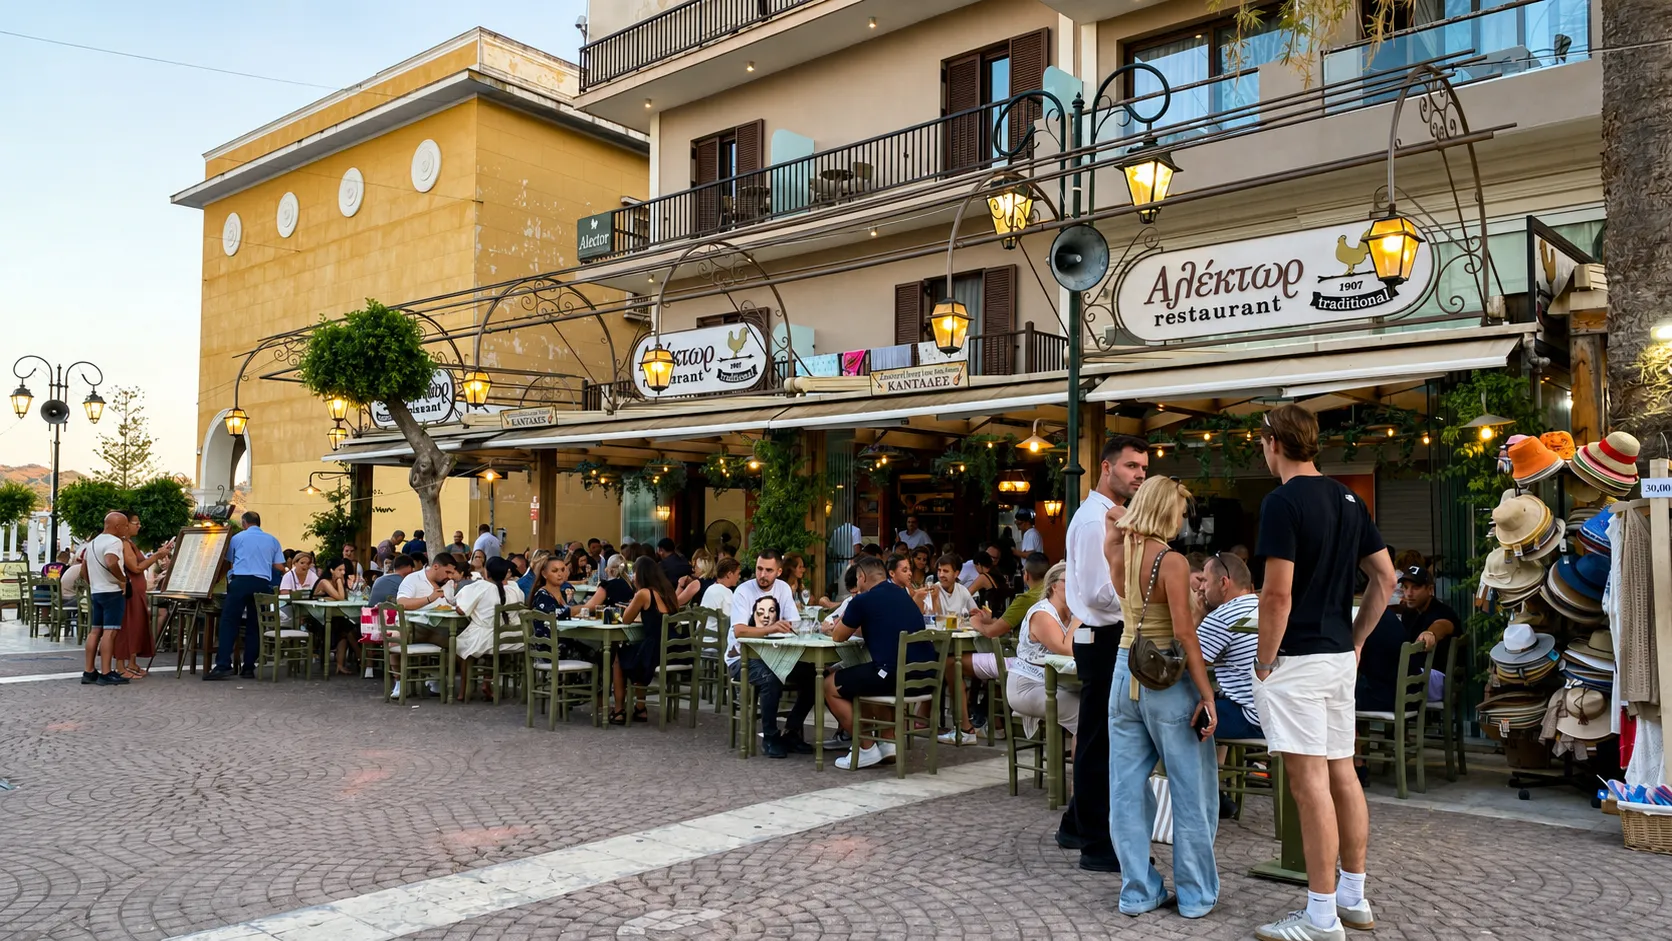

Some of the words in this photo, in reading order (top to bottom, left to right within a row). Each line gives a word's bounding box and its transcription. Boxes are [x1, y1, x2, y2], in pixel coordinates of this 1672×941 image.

[578, 233, 609, 251] Alector
[1143, 258, 1304, 309] Αλέκτωρ
[1339, 281, 1364, 292] 1907
[1317, 288, 1390, 310] traditional
[1154, 295, 1282, 327] restaurant
